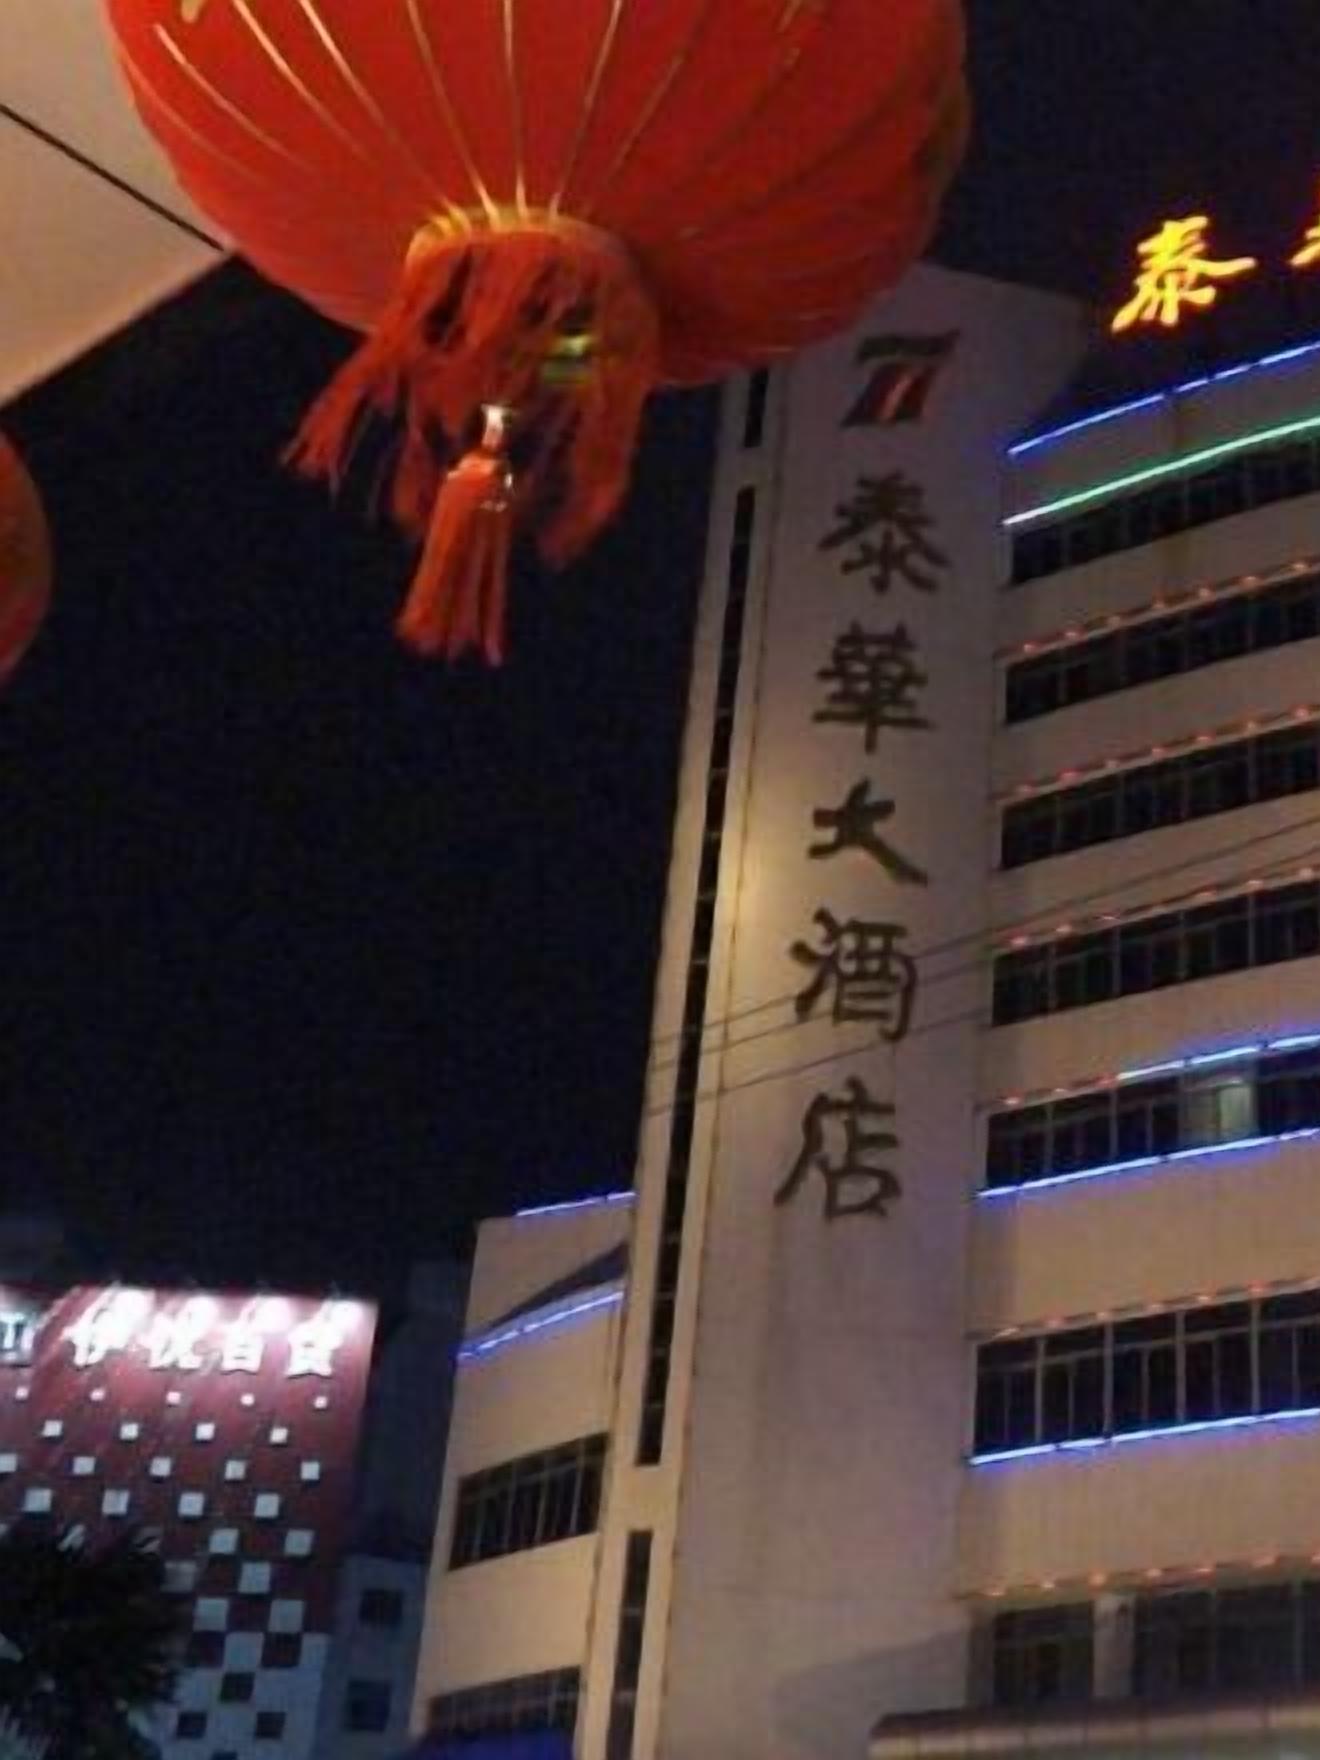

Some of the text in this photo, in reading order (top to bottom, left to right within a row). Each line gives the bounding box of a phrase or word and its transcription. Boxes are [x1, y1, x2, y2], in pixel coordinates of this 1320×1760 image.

[772, 468, 950, 1220] 泰華大酒店
